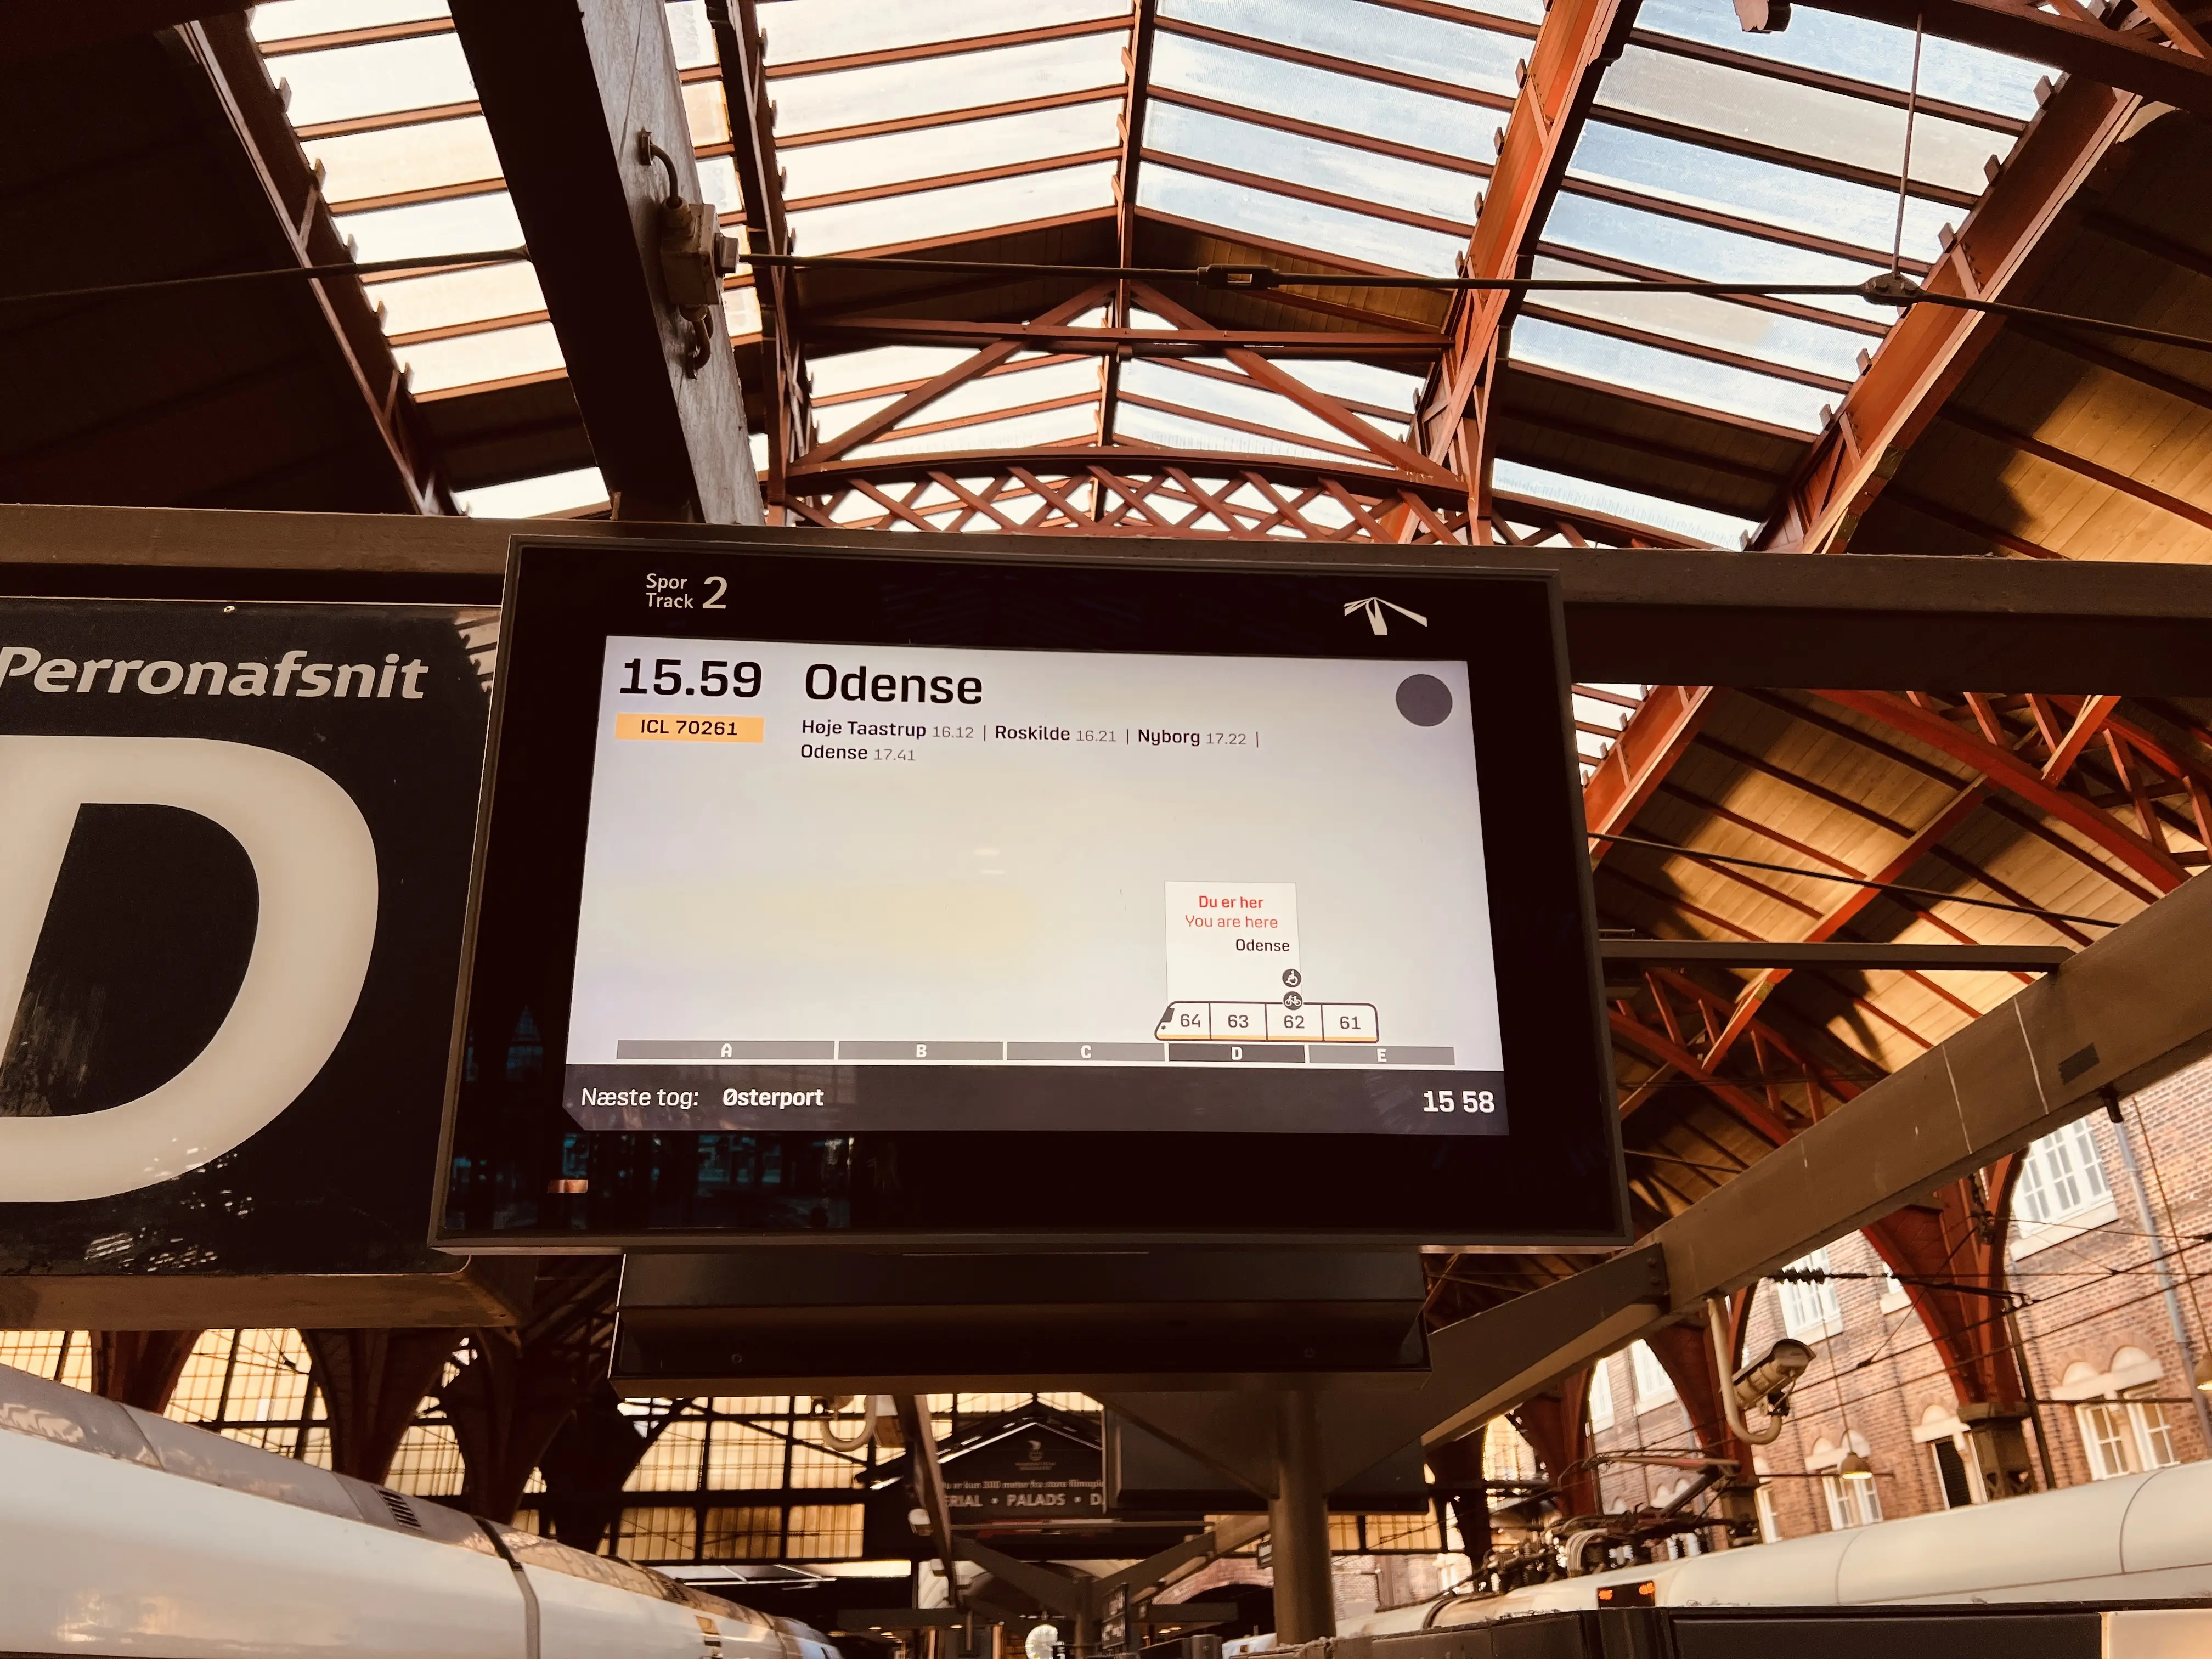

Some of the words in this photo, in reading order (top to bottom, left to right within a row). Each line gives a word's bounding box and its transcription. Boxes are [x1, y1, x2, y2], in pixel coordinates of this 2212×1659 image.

[646, 573, 687, 592] Spor
[646, 592, 694, 608] Track
[702, 576, 727, 610] 2
[0, 646, 430, 699] Perronafsnit
[620, 658, 761, 698] 15.59
[805, 664, 982, 704] Odense
[641, 719, 669, 734] ICL
[676, 720, 738, 736] 70261
[802, 719, 842, 737] Høje
[847, 721, 926, 739] Taastrup
[933, 726, 973, 738] 16.12
[995, 725, 1070, 741] Roskilde
[1076, 730, 1116, 742] 16.21
[1138, 729, 1200, 747] Nyborg
[1207, 733, 1246, 745] 17.22
[801, 744, 867, 759] Odense
[874, 749, 915, 761] 17.41
[1199, 895, 1217, 908] Du
[1222, 899, 1236, 908] er
[1240, 896, 1264, 909] her
[1186, 915, 1212, 927] You
[1217, 918, 1240, 928] are
[1245, 916, 1278, 928] here
[1235, 939, 1290, 952] Odense
[0, 735, 379, 1202] D
[1180, 1014, 1201, 1028] 64
[1228, 1014, 1249, 1028] 63
[1284, 1015, 1305, 1029] 62
[1340, 1016, 1361, 1030] 61
[720, 1043, 732, 1057] A
[916, 1043, 927, 1058] B
[1081, 1045, 1092, 1059] C
[1231, 1046, 1243, 1060] D
[1376, 1048, 1387, 1062] E
[581, 1087, 651, 1106] Næste
[657, 1088, 699, 1110] tog:
[723, 1088, 825, 1110] Østerport
[1423, 1090, 1455, 1113] 15
[1462, 1091, 1495, 1113] 58
[1007, 1493, 1066, 1506] PALADS
